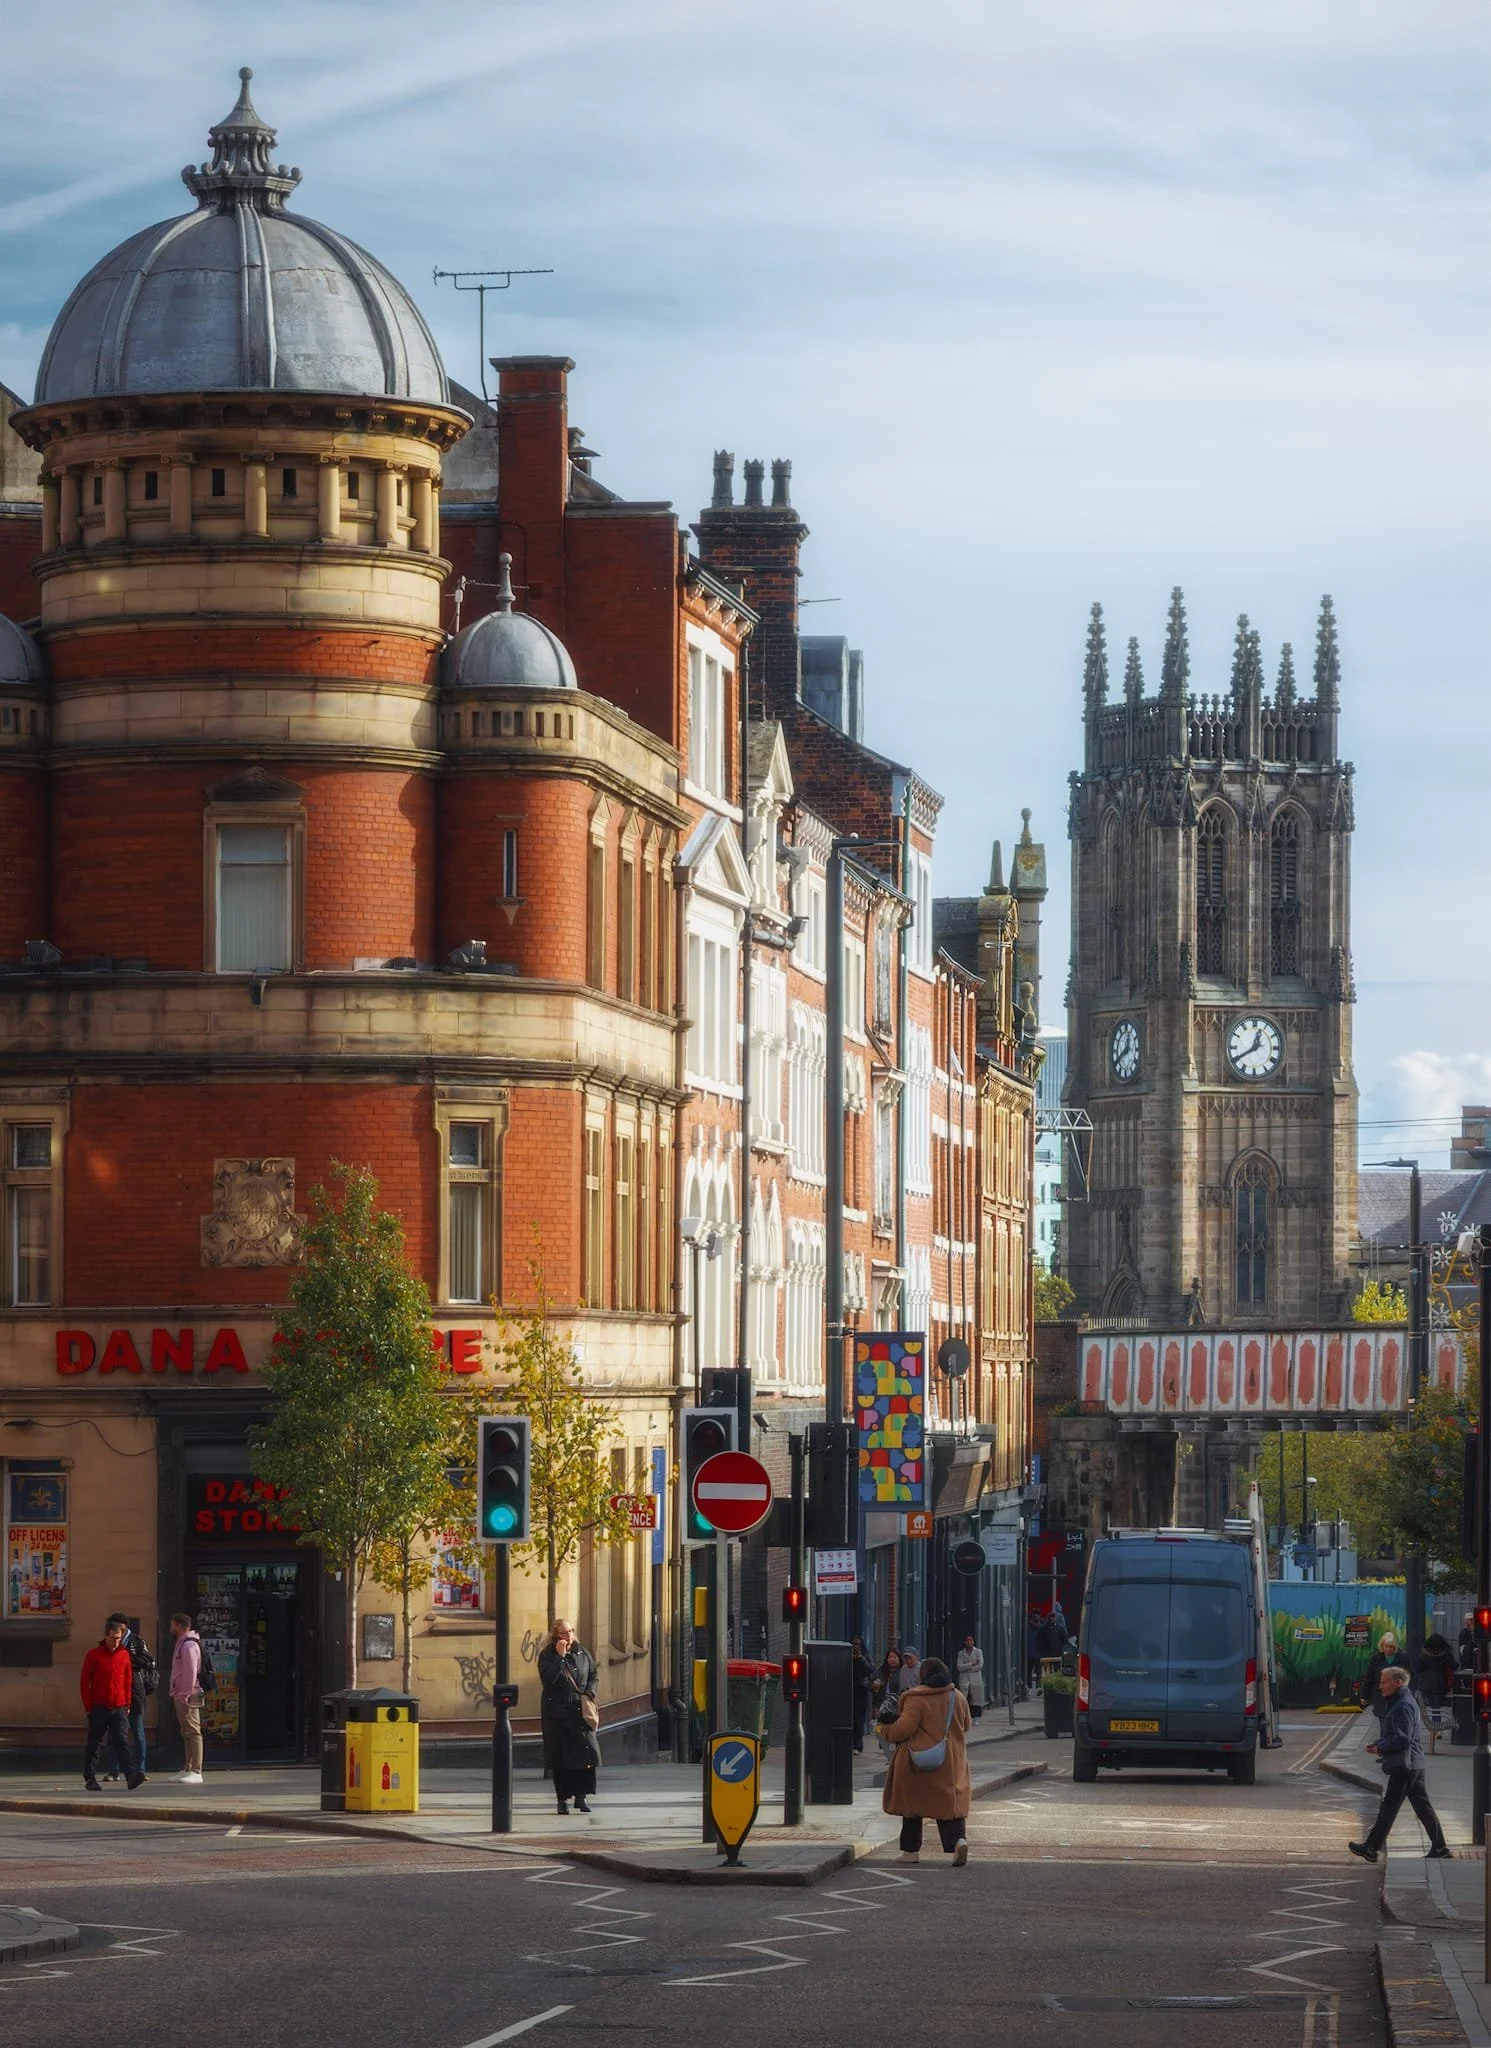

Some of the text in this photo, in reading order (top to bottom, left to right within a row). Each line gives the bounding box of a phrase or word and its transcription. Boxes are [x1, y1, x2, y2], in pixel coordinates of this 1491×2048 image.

[55, 1328, 249, 1375] DANA
[205, 1479, 294, 1503] DAN
[195, 1509, 303, 1532] STOR
[9, 1529, 65, 1541] OFF LICENS
[30, 1541, 41, 1550] 24
